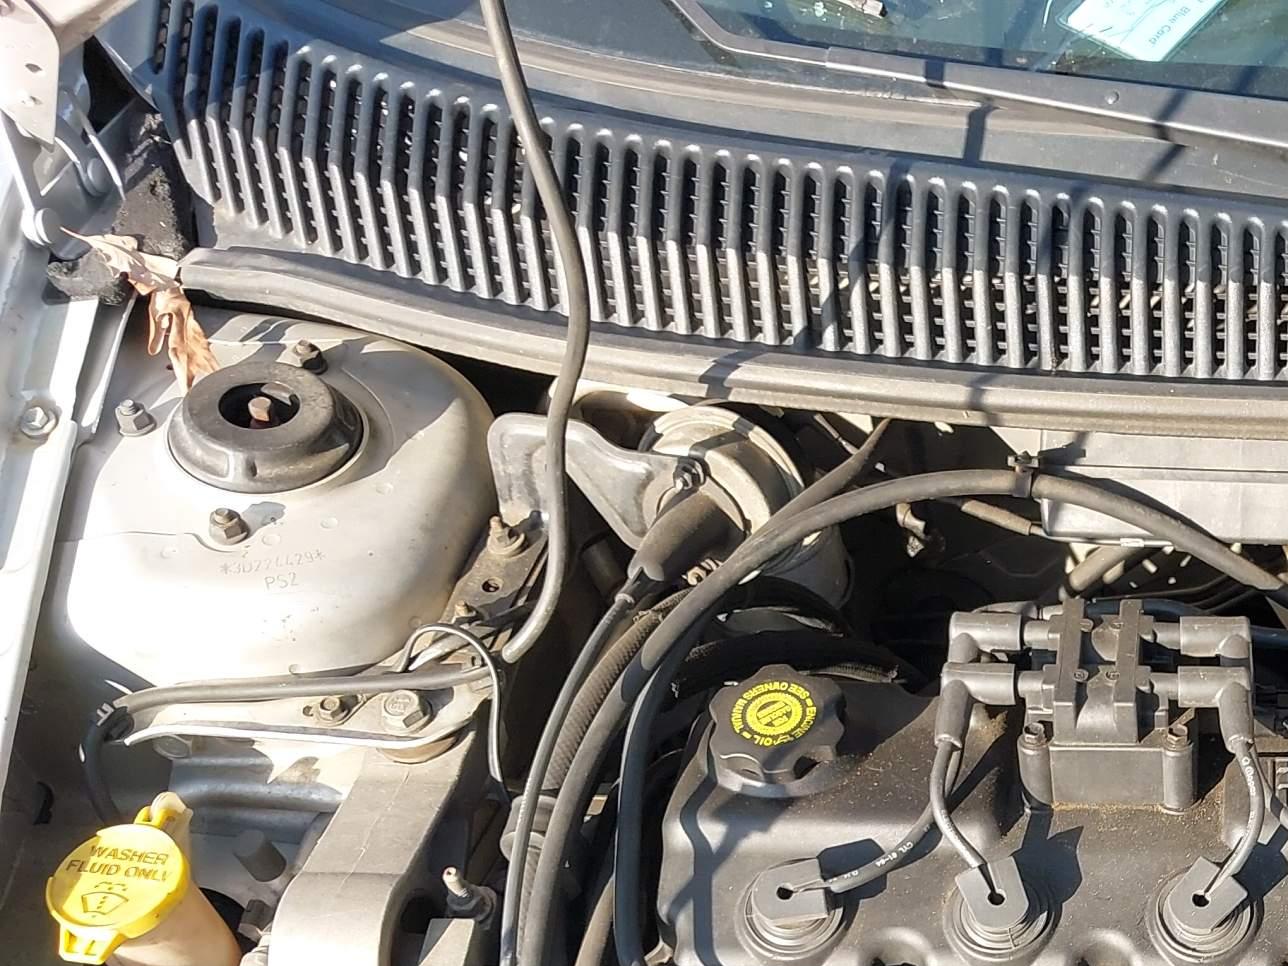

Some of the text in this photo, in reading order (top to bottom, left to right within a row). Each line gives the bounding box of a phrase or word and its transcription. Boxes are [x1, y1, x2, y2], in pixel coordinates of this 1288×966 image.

[90, 845, 169, 866] WASHER
[66, 859, 172, 882] FLUID ONLY
